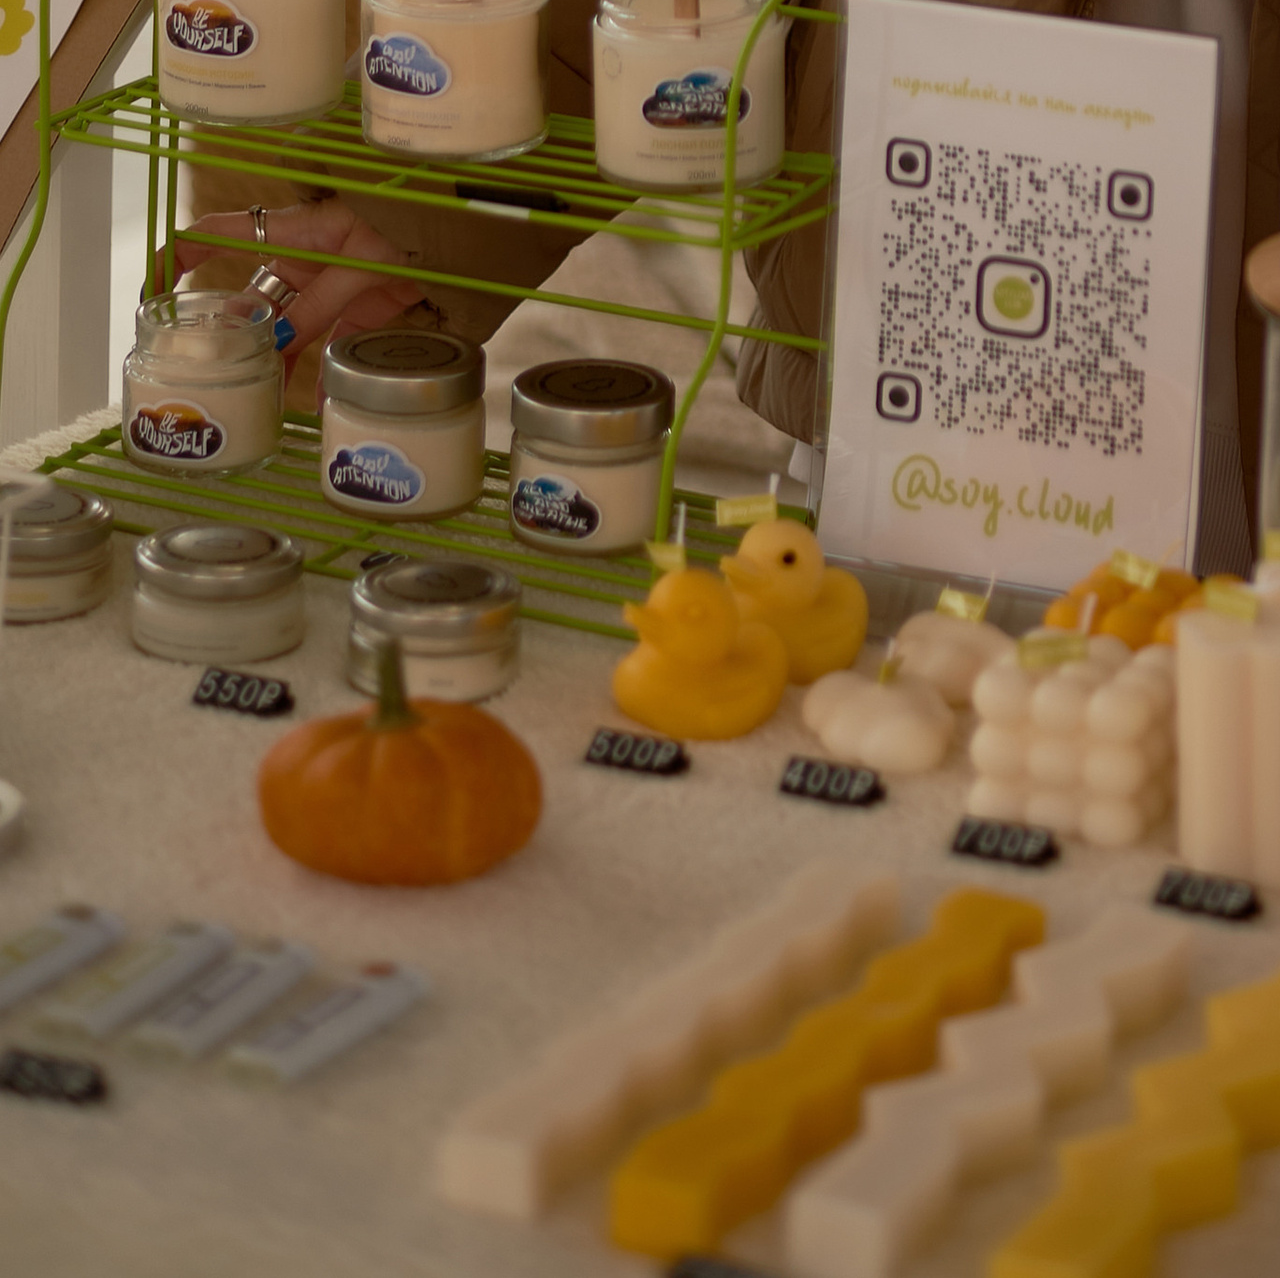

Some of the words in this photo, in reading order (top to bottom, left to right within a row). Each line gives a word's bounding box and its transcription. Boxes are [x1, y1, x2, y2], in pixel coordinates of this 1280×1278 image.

[191, 6, 214, 29] BE
[173, 12, 245, 54] YOURSELF
[184, 102, 210, 116] 200ml
[658, 101, 741, 115] BREAT
[160, 411, 183, 433] BE
[139, 415, 214, 457] YOURSELF
[891, 452, 1115, 538] @soy.cloud
